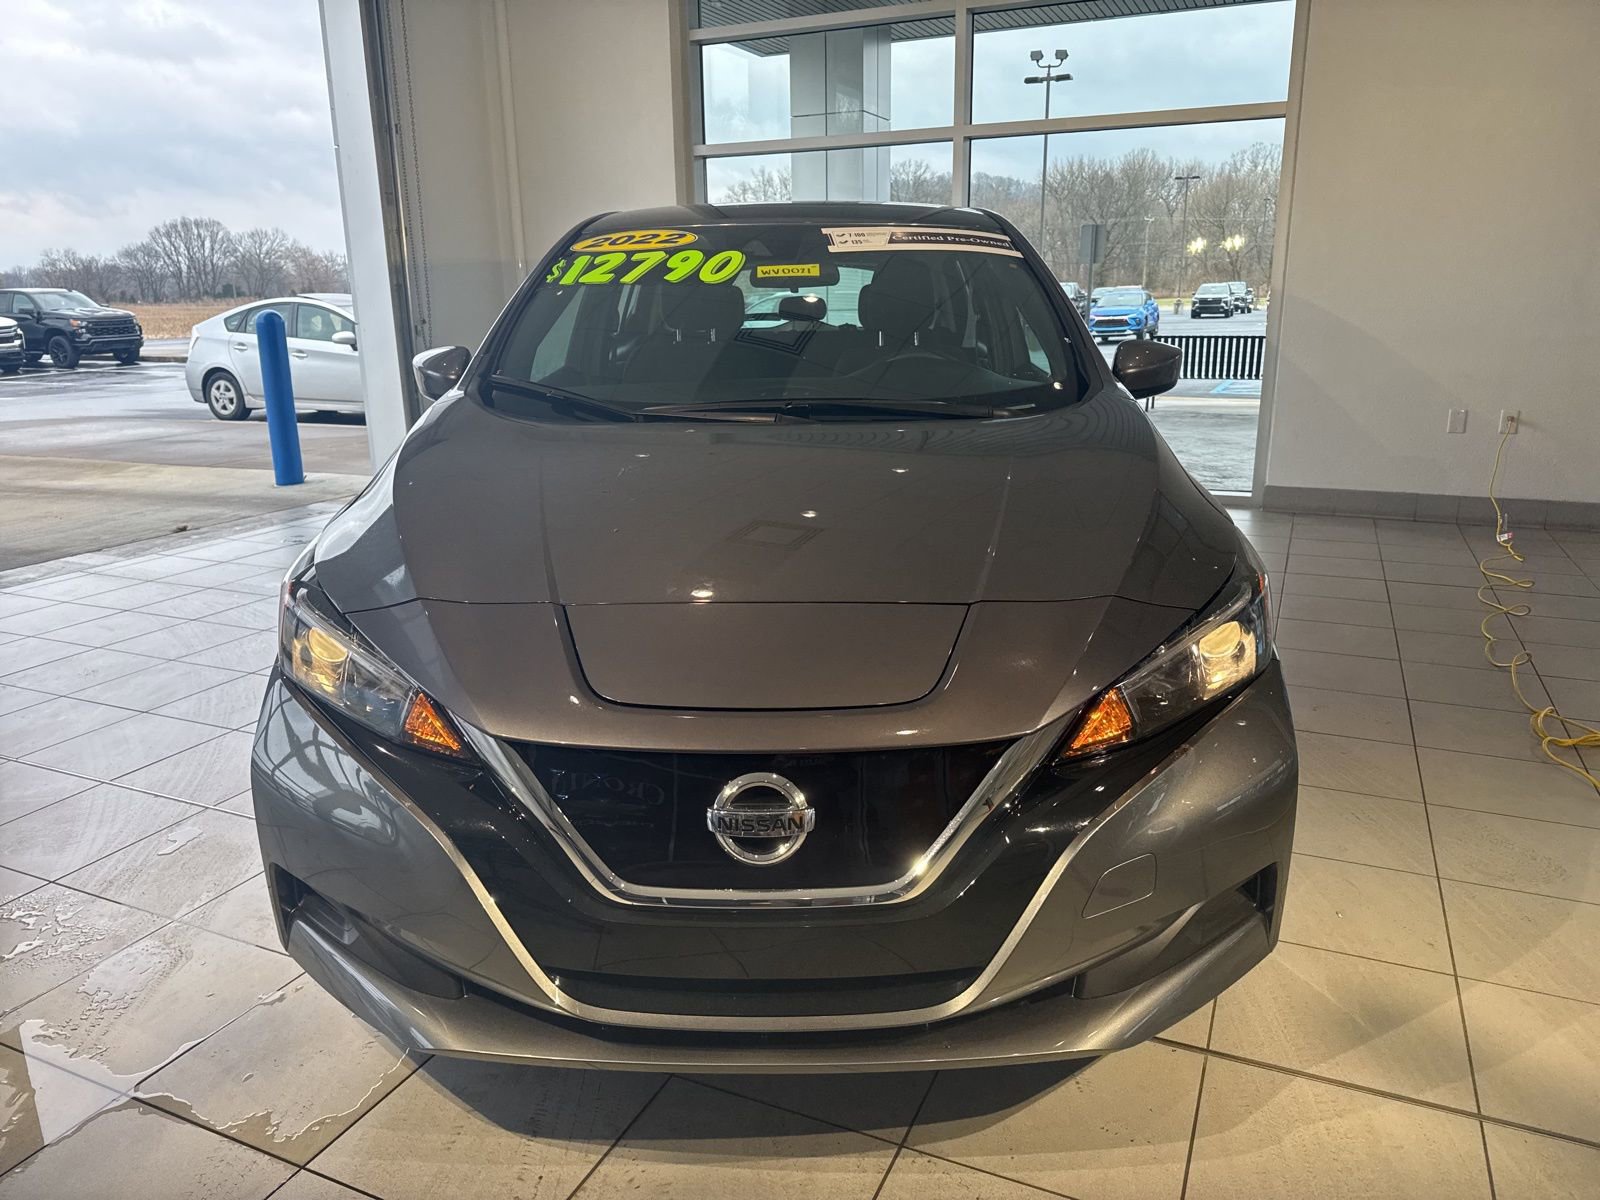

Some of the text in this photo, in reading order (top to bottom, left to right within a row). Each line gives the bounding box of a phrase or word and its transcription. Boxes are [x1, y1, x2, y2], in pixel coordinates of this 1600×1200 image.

[581, 232, 687, 249] 2022
[892, 233, 943, 242] Certified
[947, 235, 1009, 247] Pre-Owned
[546, 250, 745, 285] $12790
[717, 815, 804, 832] NISSAN
